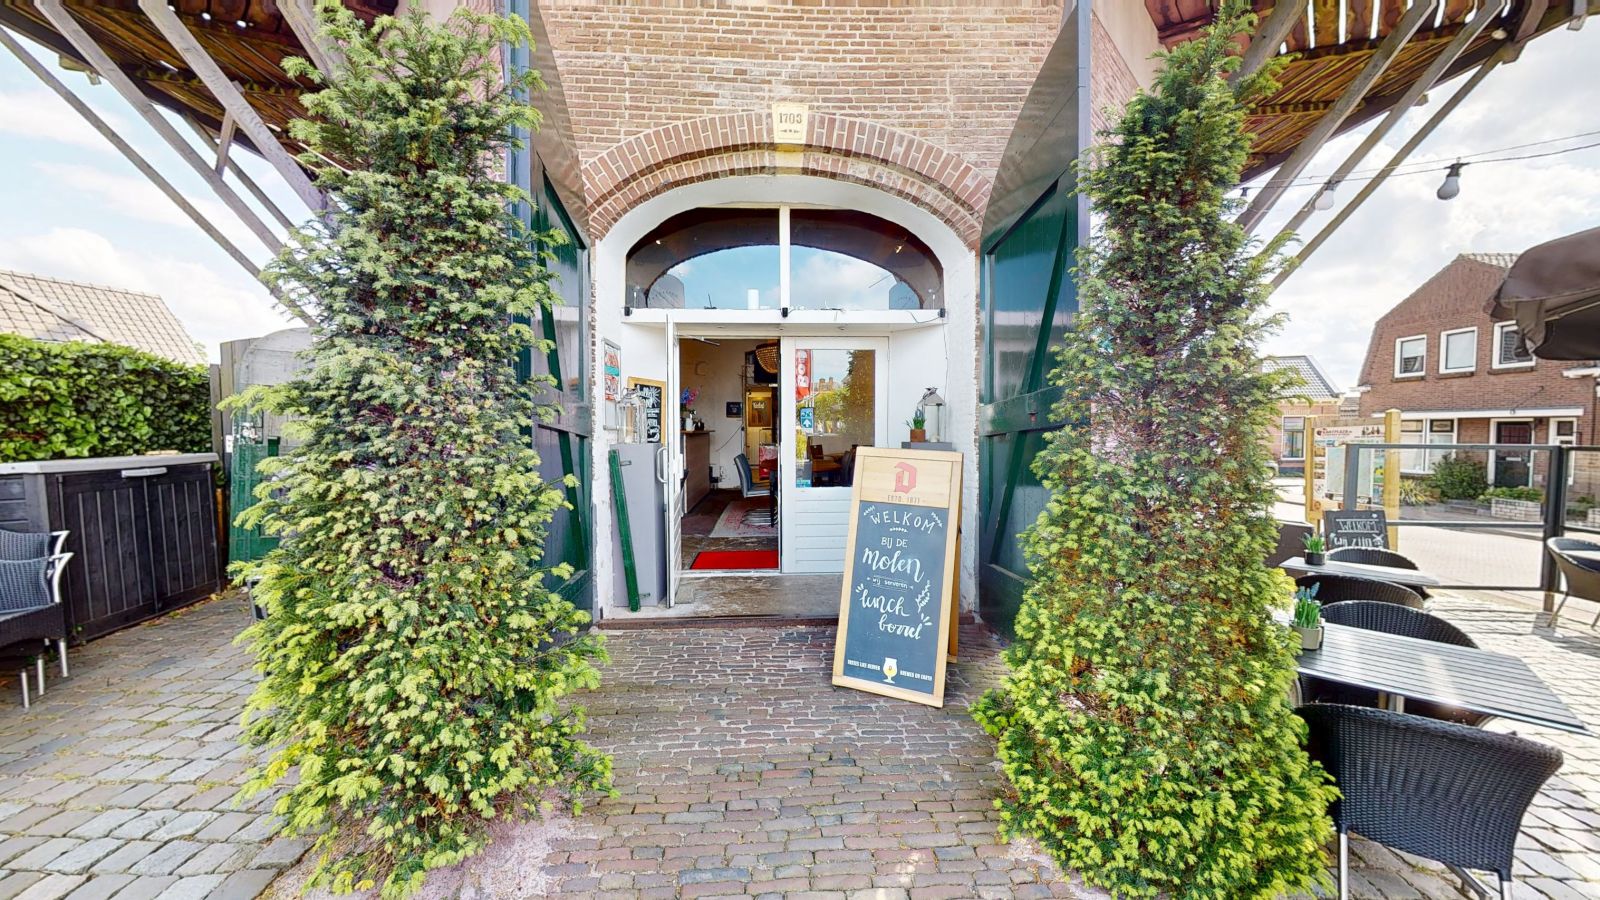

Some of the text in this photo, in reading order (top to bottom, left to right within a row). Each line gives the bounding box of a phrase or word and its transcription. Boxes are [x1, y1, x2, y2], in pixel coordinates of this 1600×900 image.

[779, 112, 802, 124] 1703
[871, 511, 935, 534] WELKOM
[1339, 520, 1377, 531] WELKOM
[881, 536, 908, 548] BIJ DE
[884, 580, 908, 589] serveren
[860, 589, 910, 617] lunch
[878, 614, 923, 640] borrel
